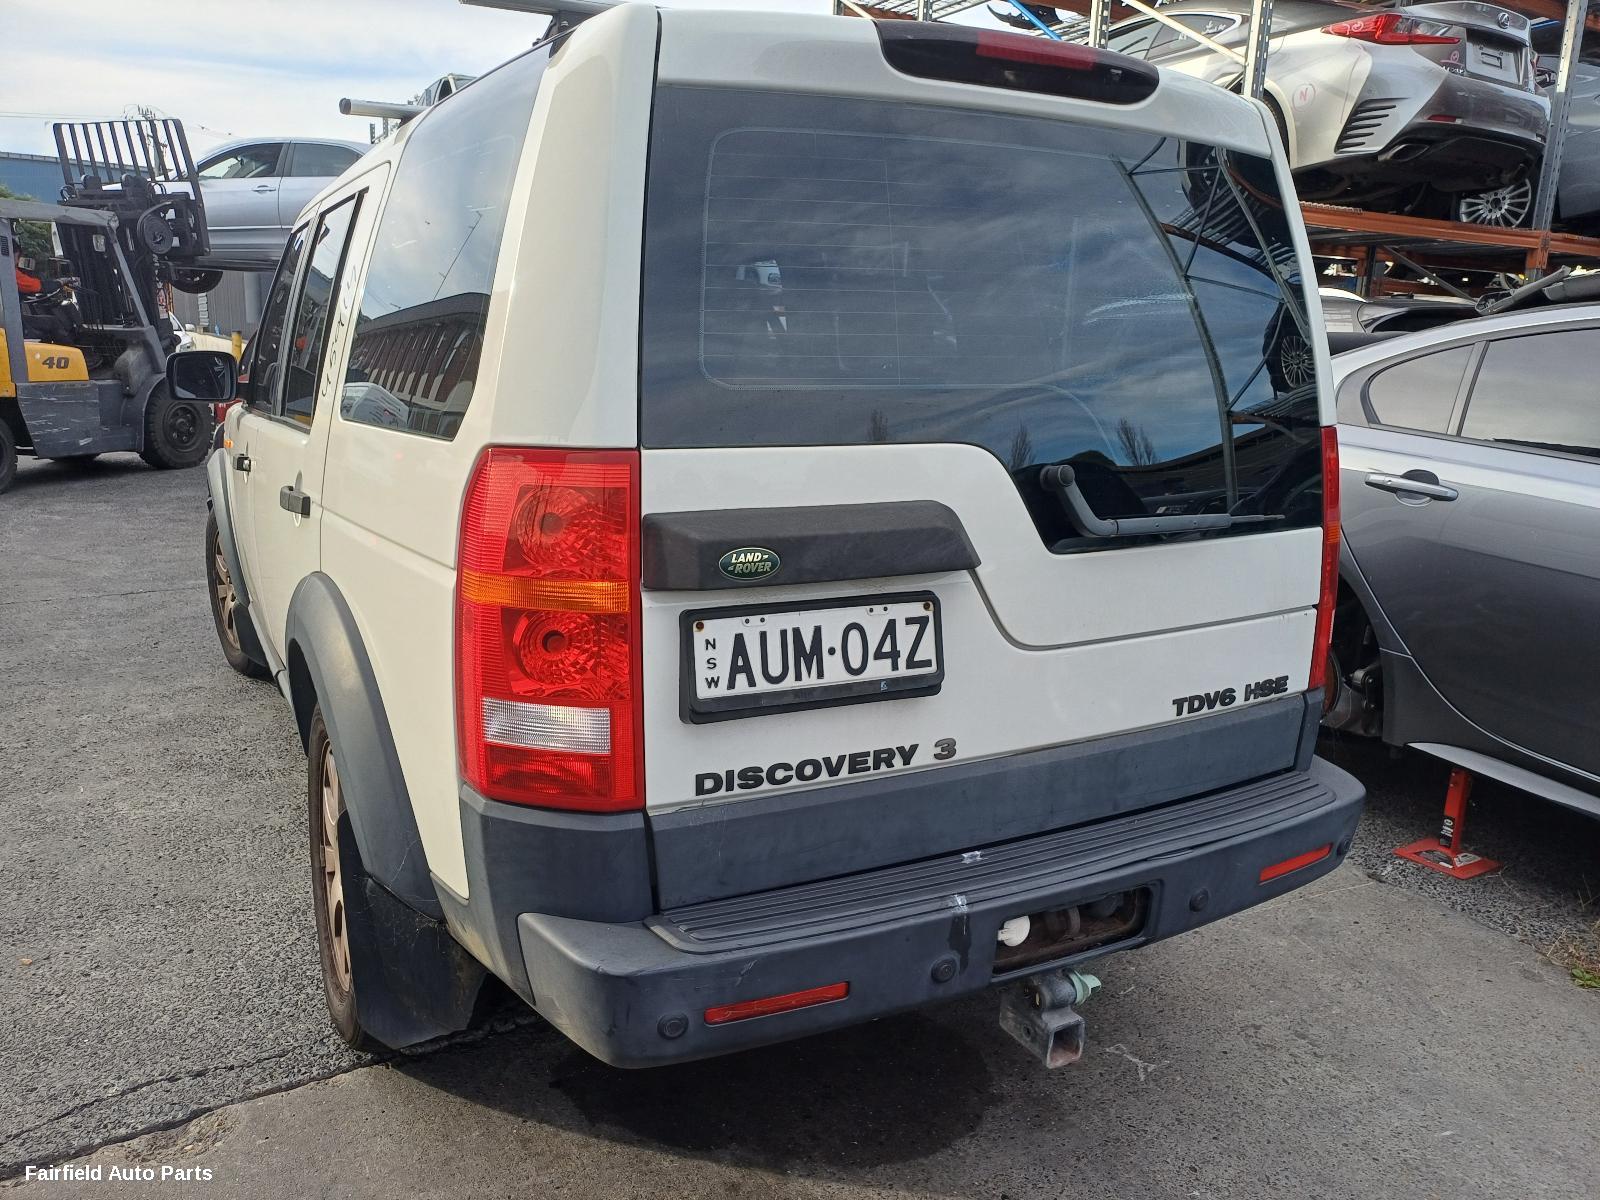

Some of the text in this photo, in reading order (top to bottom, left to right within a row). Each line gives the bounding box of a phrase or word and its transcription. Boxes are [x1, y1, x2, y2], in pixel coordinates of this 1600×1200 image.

[42, 356, 70, 370] 40
[731, 552, 762, 564] LAND
[734, 561, 772, 574] ROVER
[1243, 675, 1289, 702] HSE
[1172, 687, 1237, 717] TDV6
[933, 737, 957, 761] 3
[695, 743, 919, 797] DISCOVERY
